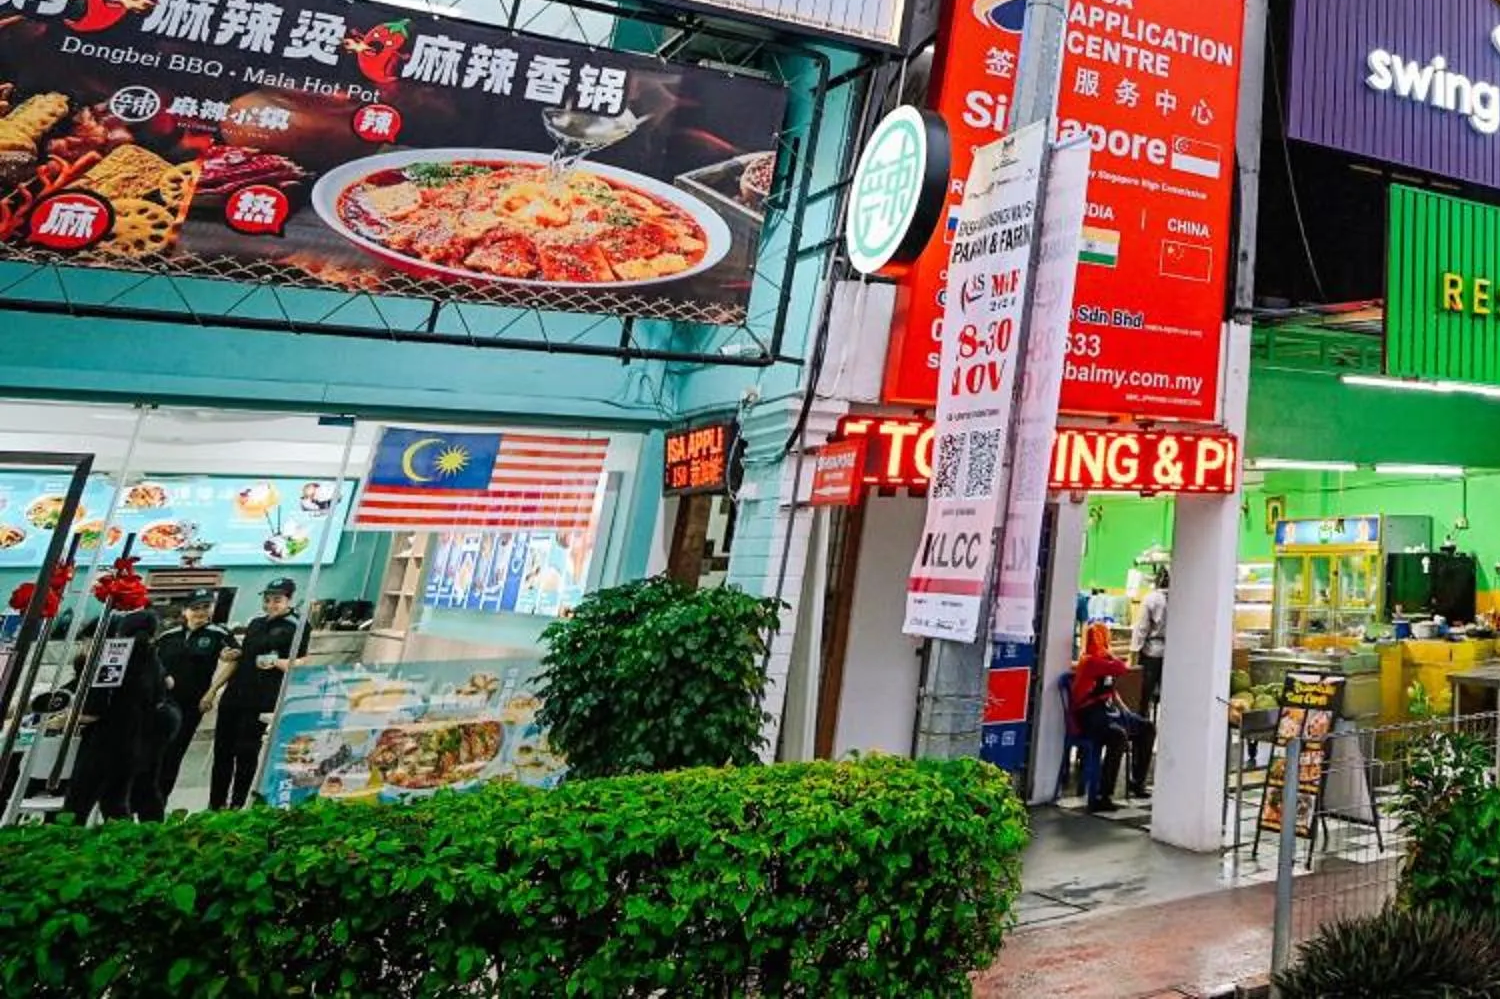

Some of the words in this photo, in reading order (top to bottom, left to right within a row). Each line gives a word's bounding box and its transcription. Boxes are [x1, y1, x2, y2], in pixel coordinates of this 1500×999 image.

[1066, 30, 1171, 78] CENTRE
[1069, 3, 1233, 67] APPLICATION
[61, 36, 161, 68] Dongbei
[168, 54, 223, 78] BBQ
[243, 66, 296, 90] Mala
[303, 76, 342, 97] Hot
[347, 84, 380, 104] Pot
[402, 34, 627, 115] 麻辣香锅
[1365, 48, 1500, 135] swing
[40, 202, 99, 239] 麻
[1167, 217, 1211, 239] CHINA
[1077, 304, 1109, 326] Sdn
[1112, 308, 1145, 330] Bhd
[1153, 438, 1183, 486] &
[921, 532, 982, 570] KLCC
